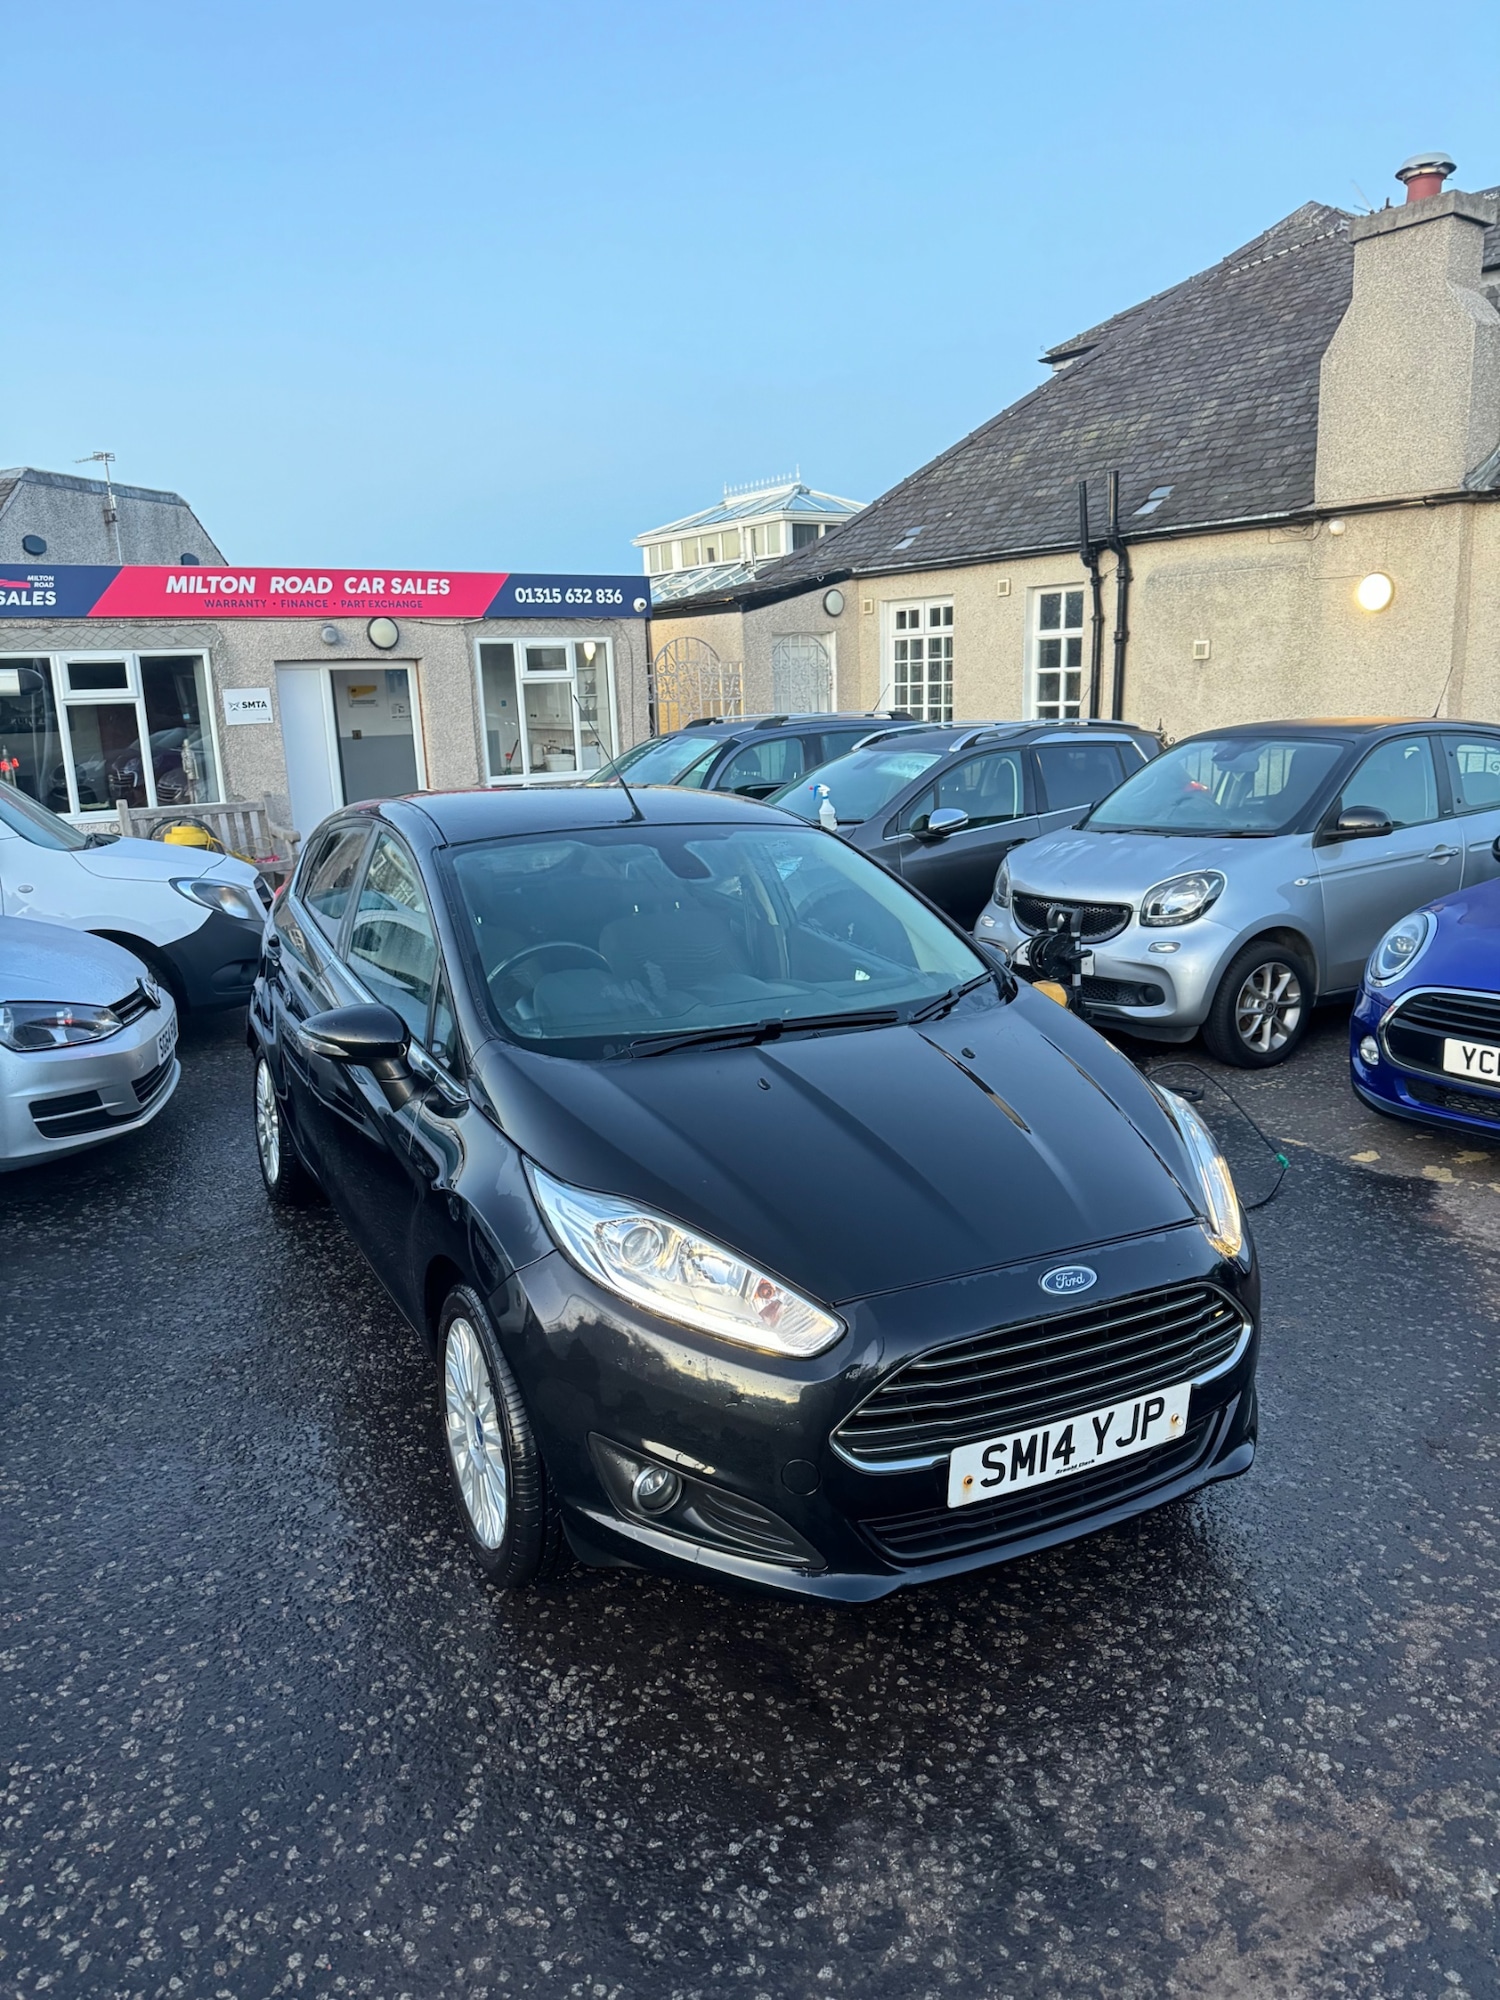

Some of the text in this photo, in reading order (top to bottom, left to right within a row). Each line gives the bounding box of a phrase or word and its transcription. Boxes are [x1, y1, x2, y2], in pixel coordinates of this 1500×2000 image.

[165, 575, 451, 595] MILTON ROAD CAR SALES
[204, 599, 423, 609] WARRANTY FINANCE PART EXCHANGE
[514, 587, 623, 604] 01315 632 836
[241, 701, 268, 709] SMTA
[1462, 1045, 1500, 1077] YC
[1055, 1271, 1086, 1289] Ford
[980, 1396, 1165, 1488] SM14 YJP
